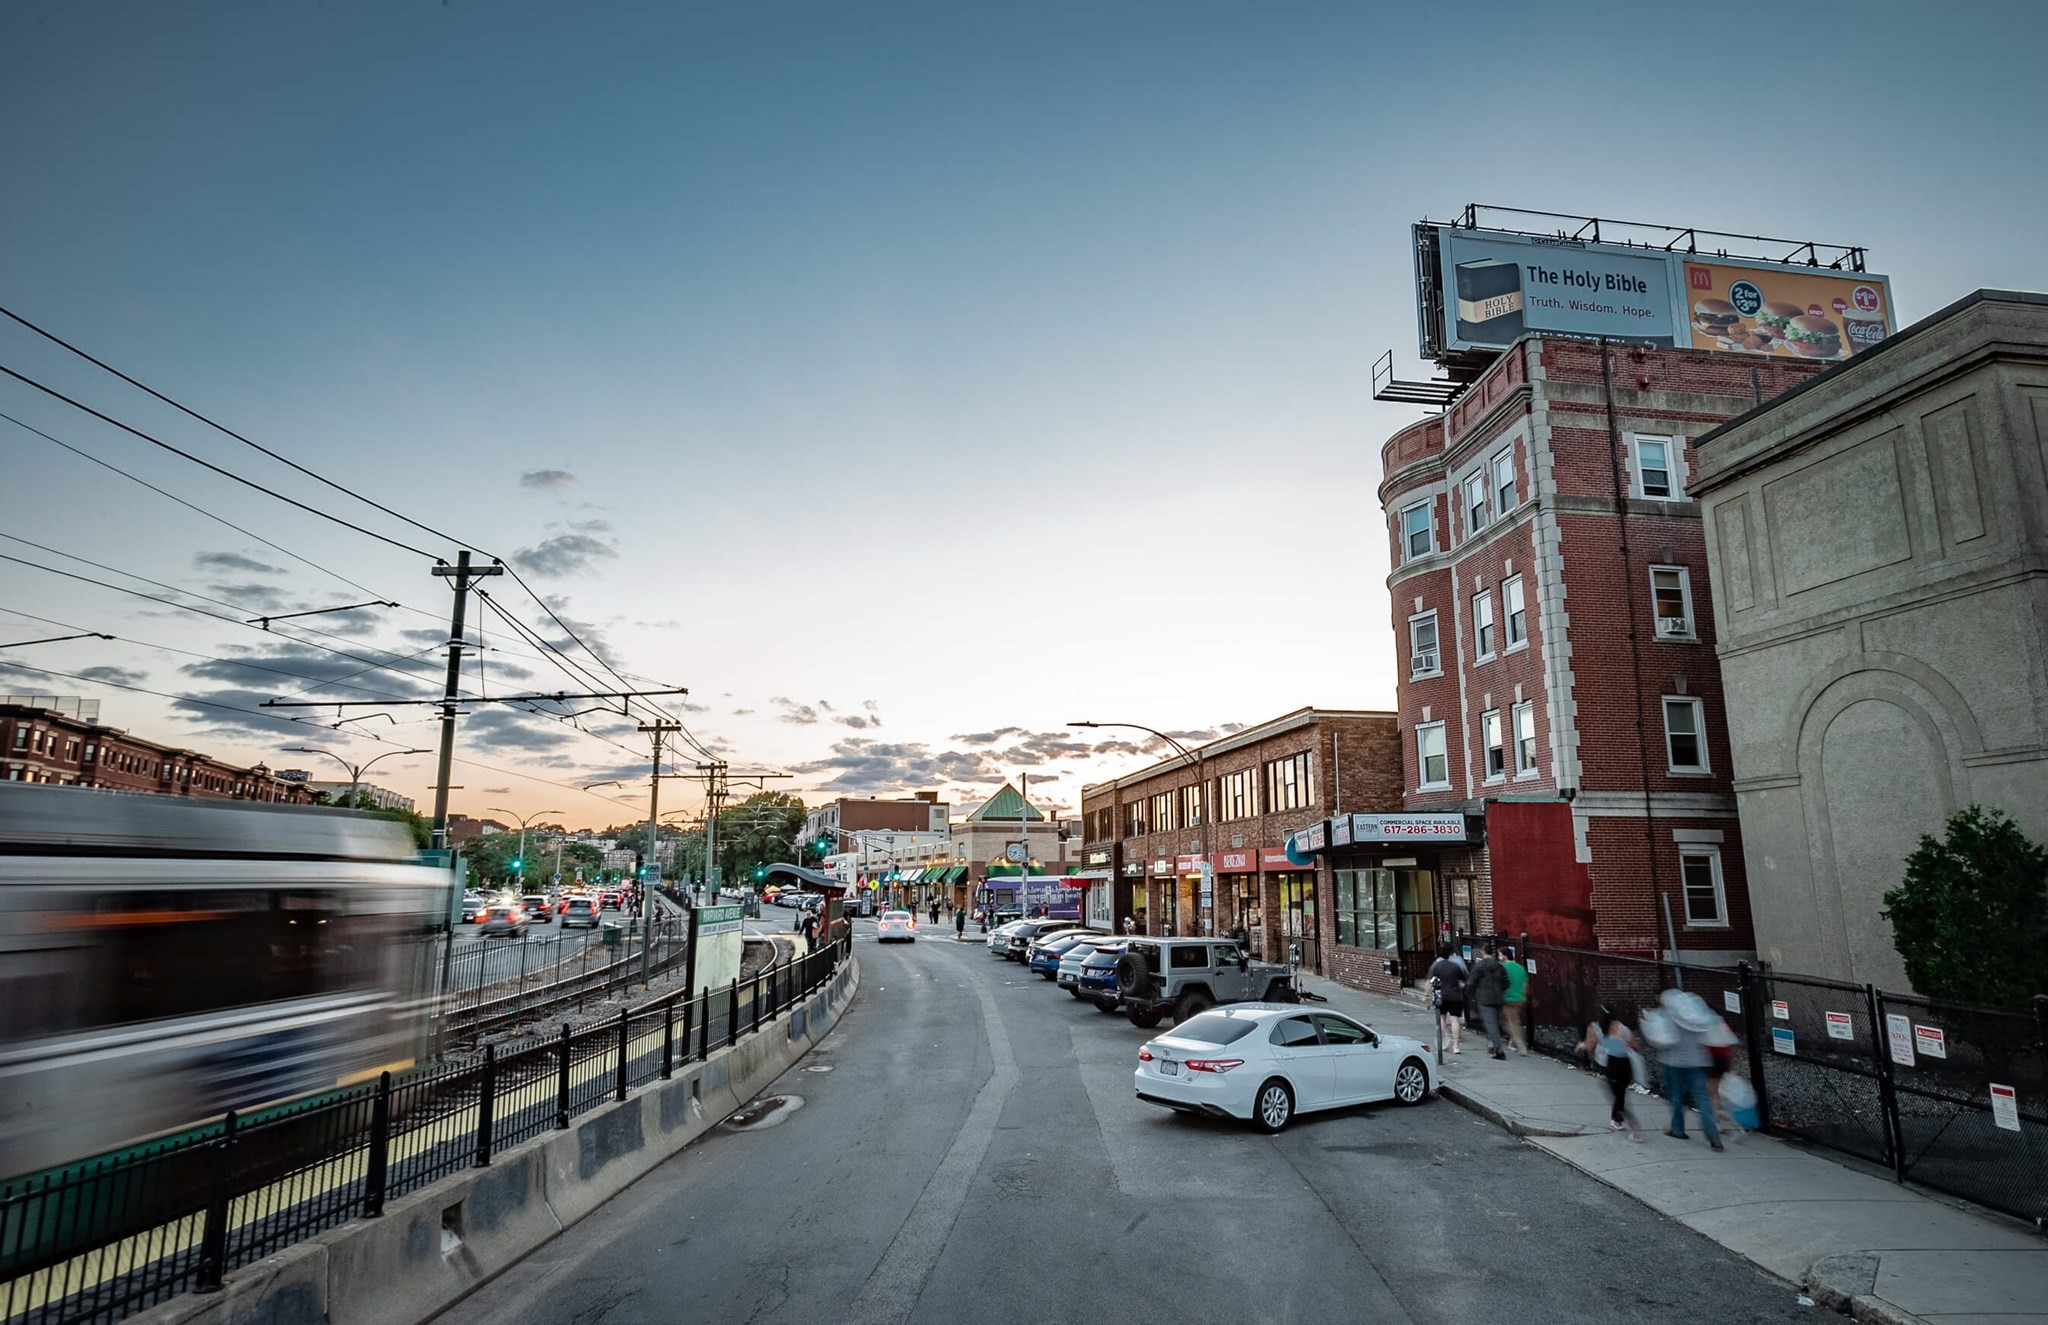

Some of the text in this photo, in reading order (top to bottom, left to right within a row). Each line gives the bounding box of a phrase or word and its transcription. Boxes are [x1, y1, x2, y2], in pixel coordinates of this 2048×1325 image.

[1526, 265, 1647, 293] The Holy Bible
[1734, 287, 1744, 299] 2
[1485, 295, 1513, 309] HOLY
[1530, 296, 1655, 319] Truth. Wisdom. Hope.
[1484, 303, 1515, 319] BIBLE
[1384, 826, 1460, 834] 617-286-3830
